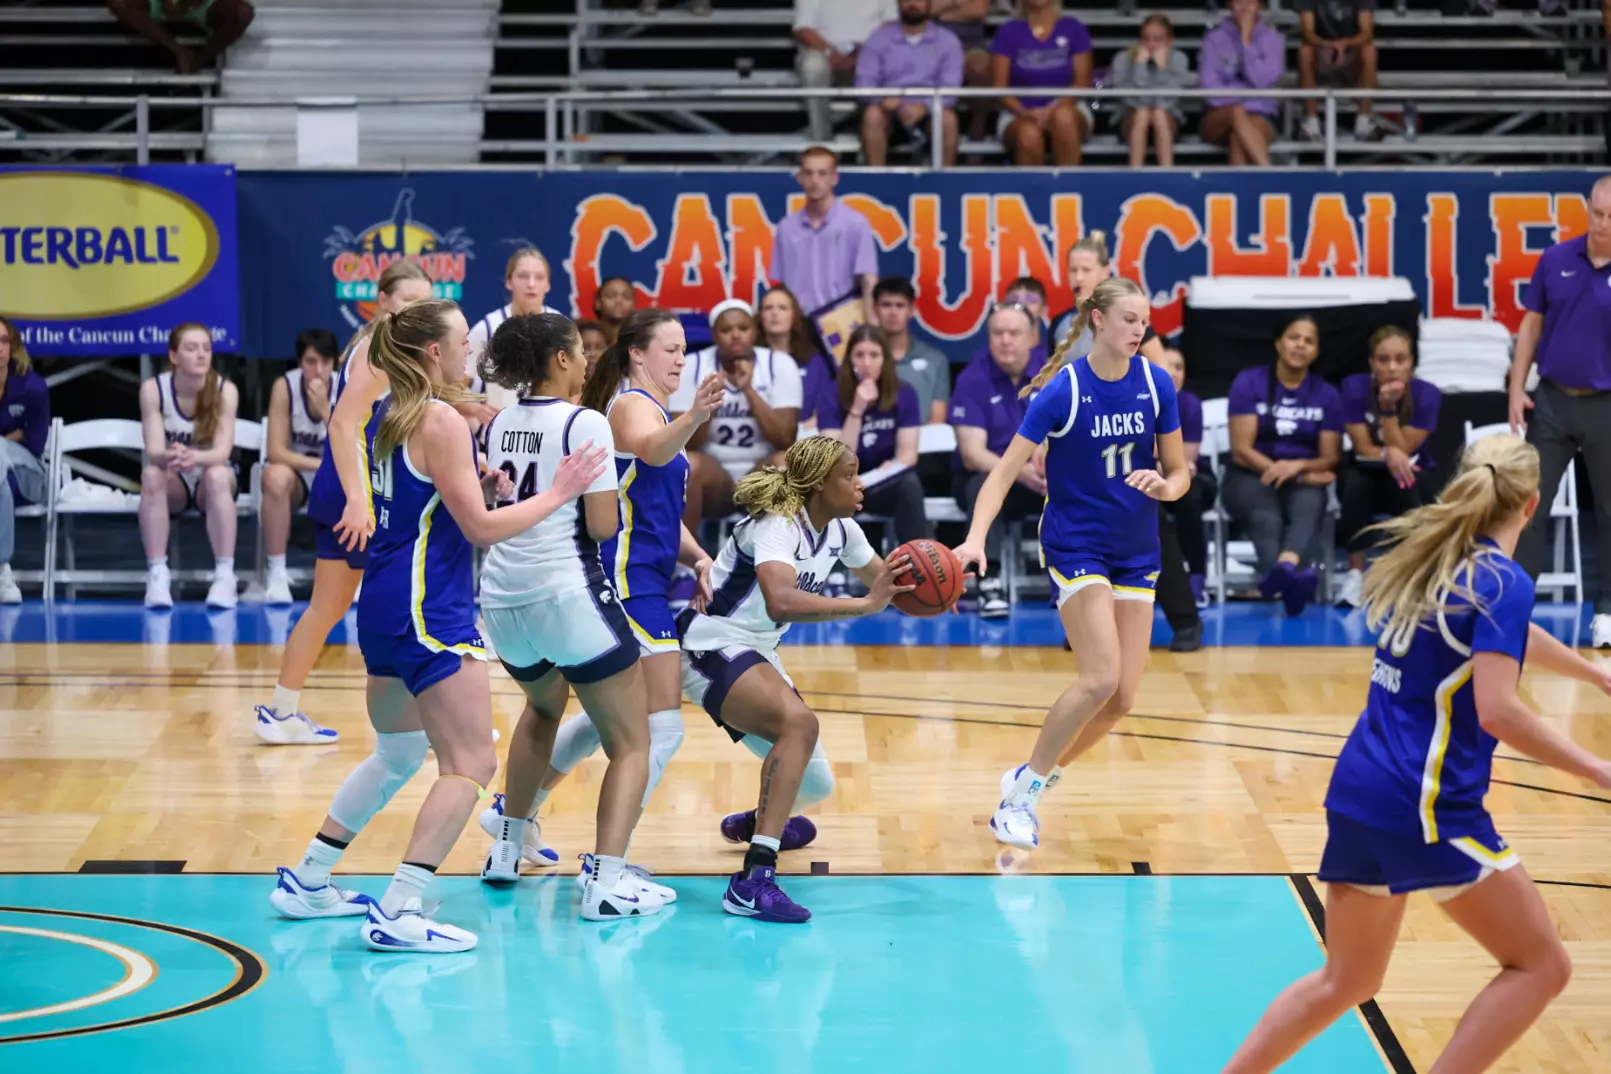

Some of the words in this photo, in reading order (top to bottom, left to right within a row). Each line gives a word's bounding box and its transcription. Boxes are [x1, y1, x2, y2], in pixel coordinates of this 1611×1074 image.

[332, 252, 466, 284] CAUN
[1114, 193, 1590, 340] CHALLE
[36, 326, 64, 345] the
[68, 326, 135, 345] Cancun
[717, 424, 754, 448] 22
[1090, 411, 1145, 438] JACKS
[500, 430, 544, 455] COTTON
[1101, 442, 1136, 479] 11
